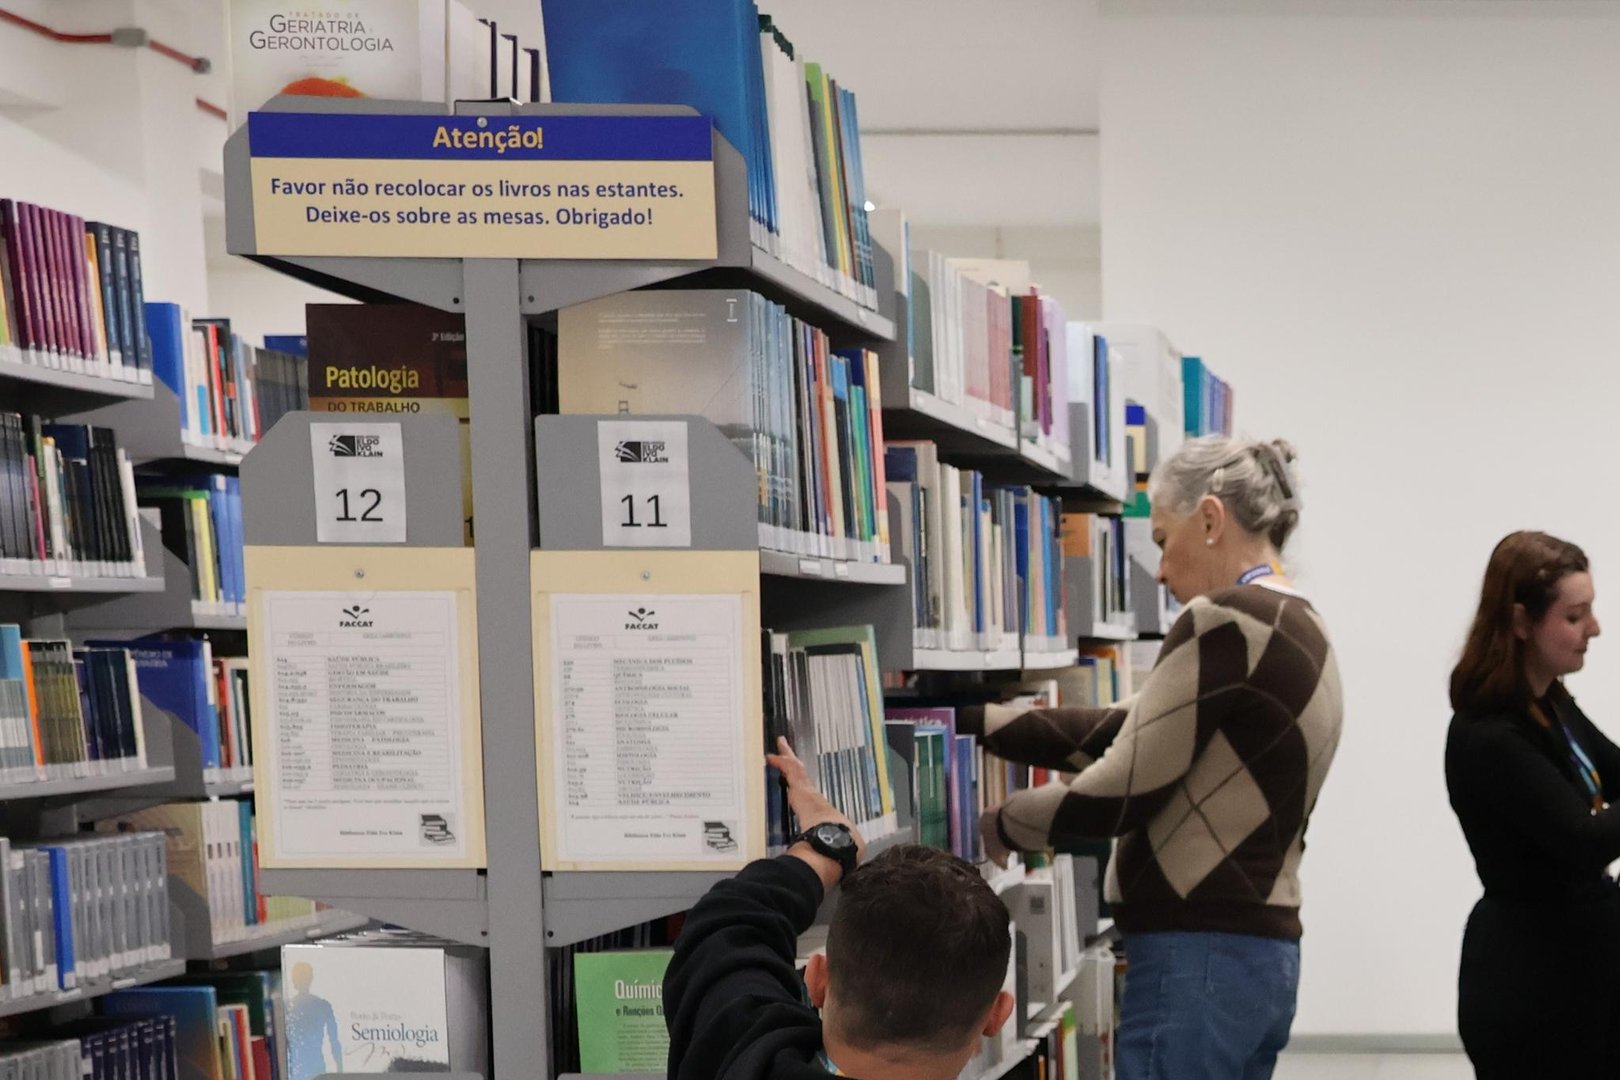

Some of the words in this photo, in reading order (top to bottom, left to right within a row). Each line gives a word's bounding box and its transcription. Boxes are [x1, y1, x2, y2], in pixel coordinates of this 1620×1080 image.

[269, 14, 366, 34] GERIATRIA
[250, 31, 394, 51] GERONTOLOGIA
[433, 125, 543, 153] Atenção!
[271, 178, 326, 195] Favor
[333, 178, 369, 196] não
[375, 179, 466, 196] recolocar
[472, 183, 493, 196] os
[500, 180, 551, 197] livros
[558, 184, 590, 197] nas
[596, 182, 684, 198] estantes.
[306, 206, 391, 223] Deixe-os
[397, 207, 451, 224] sobre
[457, 211, 477, 224] as
[484, 211, 550, 225] mesas.
[556, 208, 653, 229] Obrigado!
[325, 365, 420, 394] Patologia
[328, 402, 347, 413] DO
[350, 402, 420, 413] TRABALHO
[335, 488, 384, 522] 12
[621, 494, 668, 528] 11
[615, 979, 663, 999] Químic
[351, 1022, 439, 1048] Semiologia
